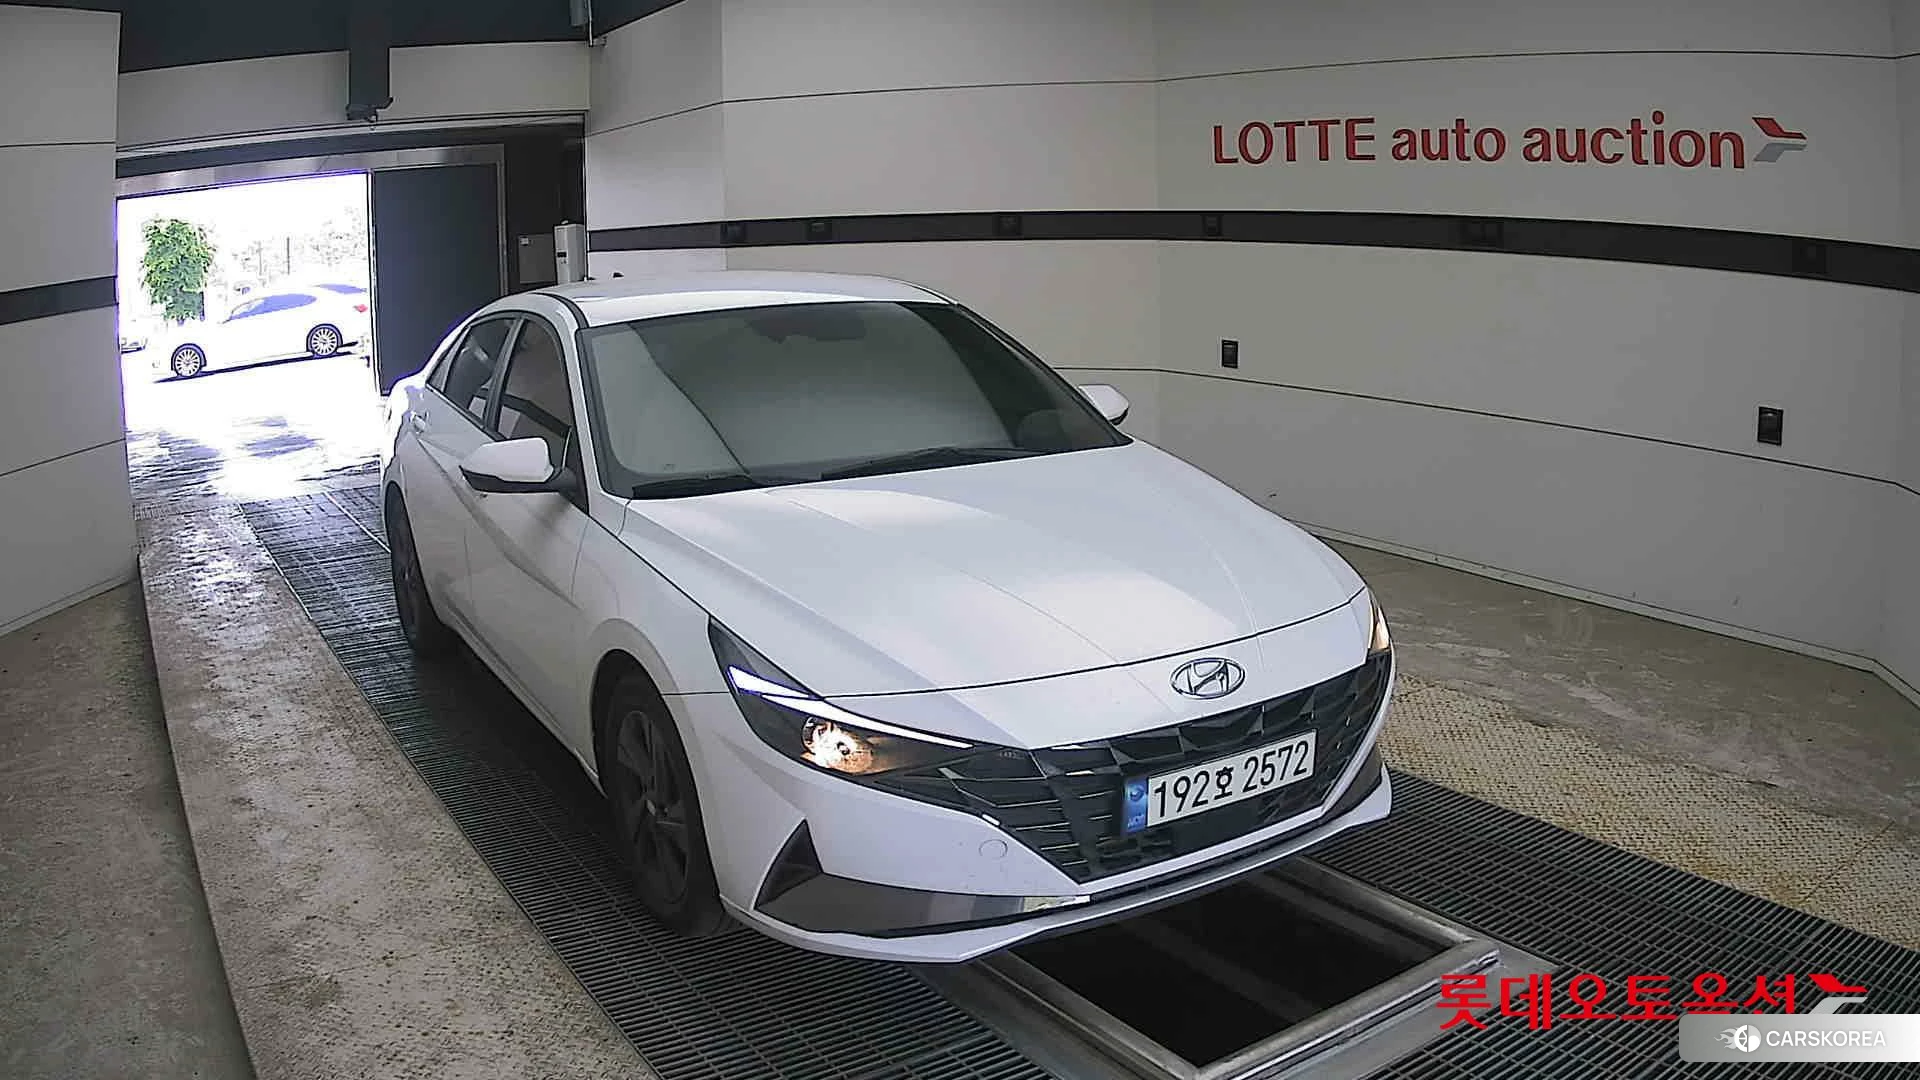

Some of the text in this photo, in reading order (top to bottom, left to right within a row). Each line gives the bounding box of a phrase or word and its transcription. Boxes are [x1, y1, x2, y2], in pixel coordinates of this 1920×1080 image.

[1212, 111, 1746, 169] LOTTE auto auction
[1154, 740, 1309, 818] 192호 2572
